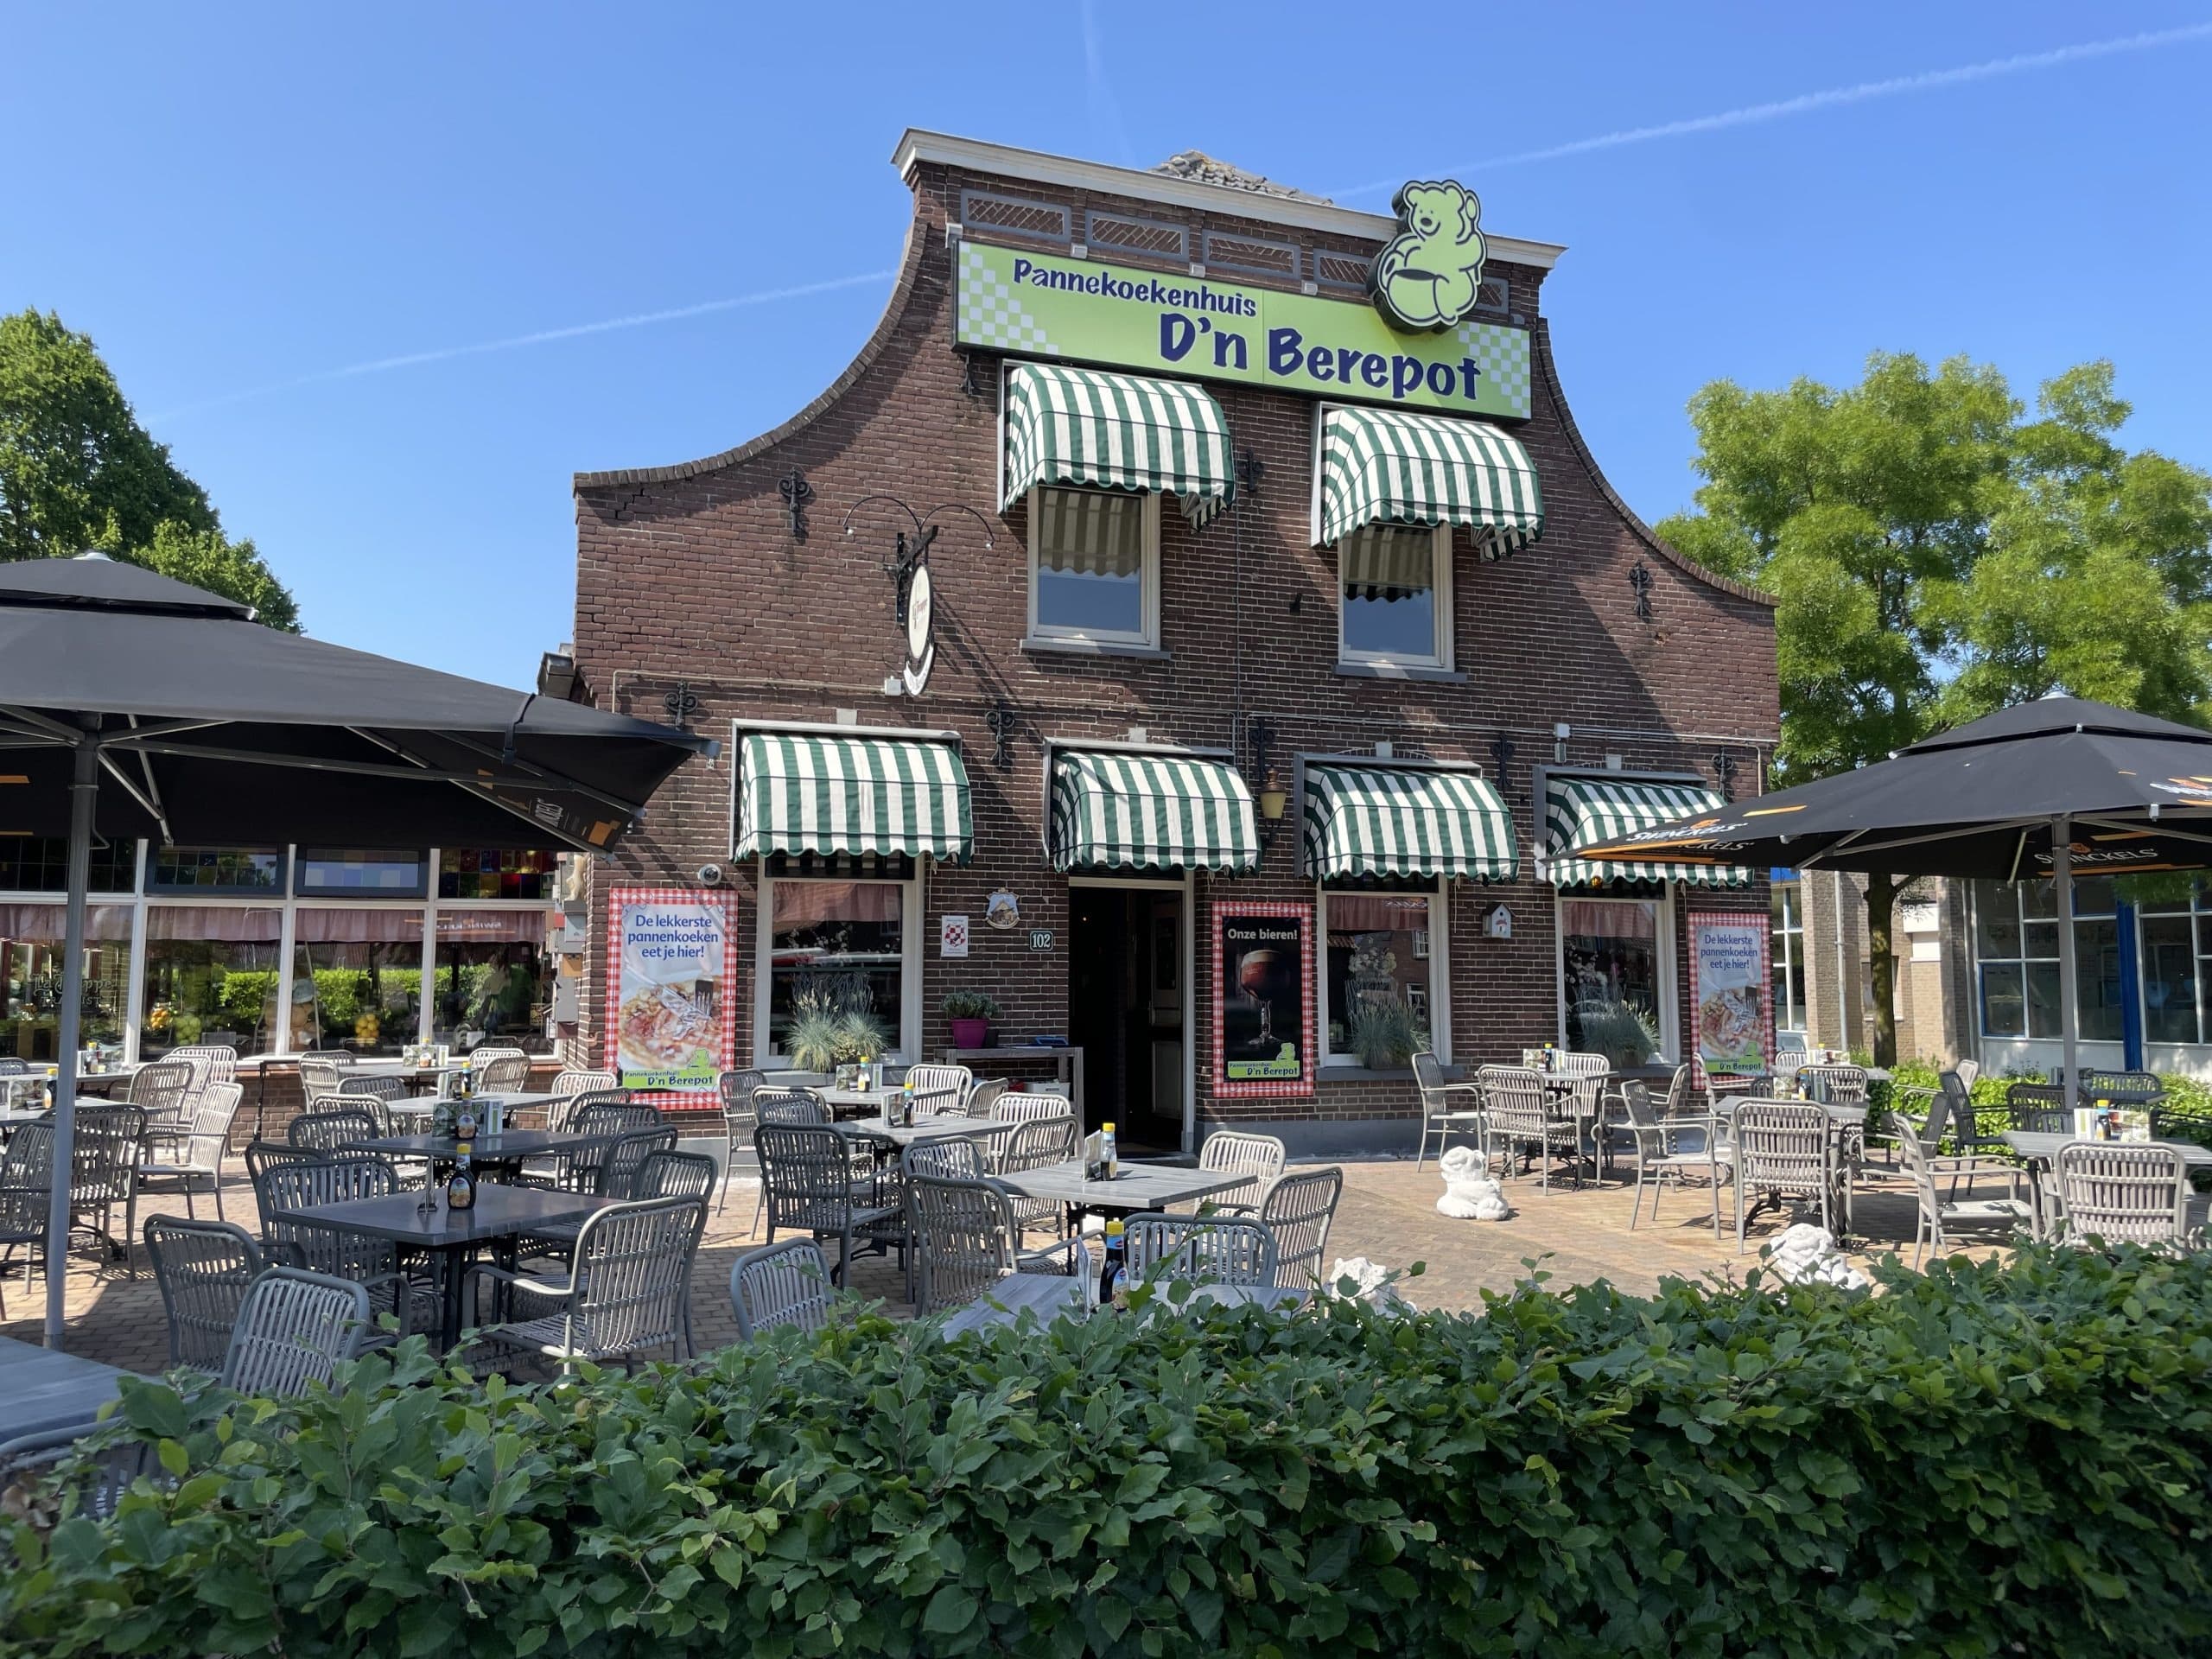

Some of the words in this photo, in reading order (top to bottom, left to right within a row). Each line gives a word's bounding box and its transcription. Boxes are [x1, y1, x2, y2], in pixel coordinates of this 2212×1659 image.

[1013, 258, 1256, 318] Pannekoekenhuis
[1160, 313, 1248, 370] D'n
[1268, 327, 1482, 400] Berepot
[635, 914, 654, 927] De
[656, 914, 712, 928] lekkerste
[627, 930, 719, 944] pannenkoeken
[1032, 933, 1051, 948] 102
[1227, 928, 1256, 940] Onze
[1259, 928, 1298, 940] bieren!
[1704, 934, 1716, 944] De
[1717, 934, 1753, 945] lekkerste
[641, 945, 661, 958] eet
[663, 945, 676, 961] je
[677, 944, 705, 958] hier!
[1700, 946, 1758, 957] pannenkoeken
[1709, 959, 1724, 969] eet
[1724, 959, 1732, 971] je
[1732, 958, 1750, 969] hier!
[1263, 1067, 1298, 1077] Berepot
[647, 1077, 665, 1086] D'n
[669, 1076, 713, 1087] Berepot
